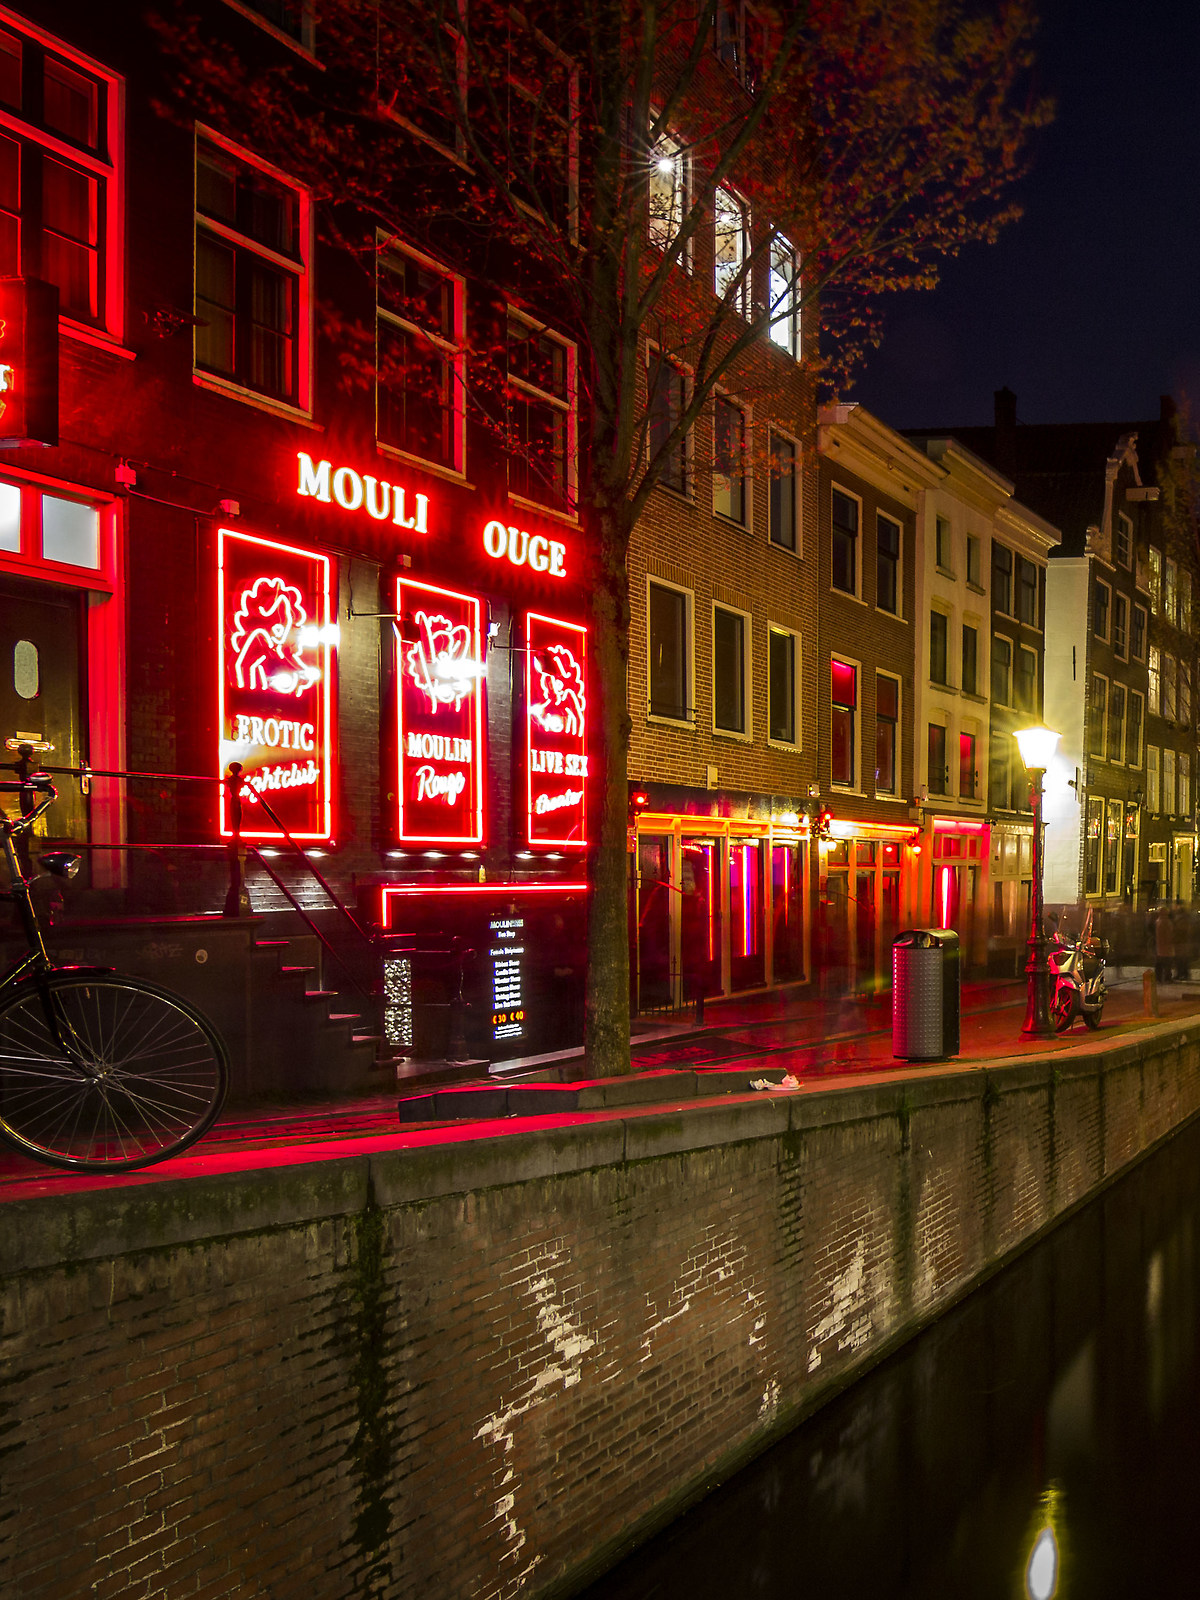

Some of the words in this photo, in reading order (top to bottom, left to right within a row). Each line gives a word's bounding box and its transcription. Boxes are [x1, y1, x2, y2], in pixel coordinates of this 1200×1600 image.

[296, 451, 429, 534] MOULI
[483, 520, 567, 578] OUGE
[235, 714, 315, 752] EROTIC
[407, 731, 472, 763] MOULIN
[530, 749, 563, 773] LIVE
[564, 753, 589, 777] SEX
[415, 765, 466, 806] Rouge
